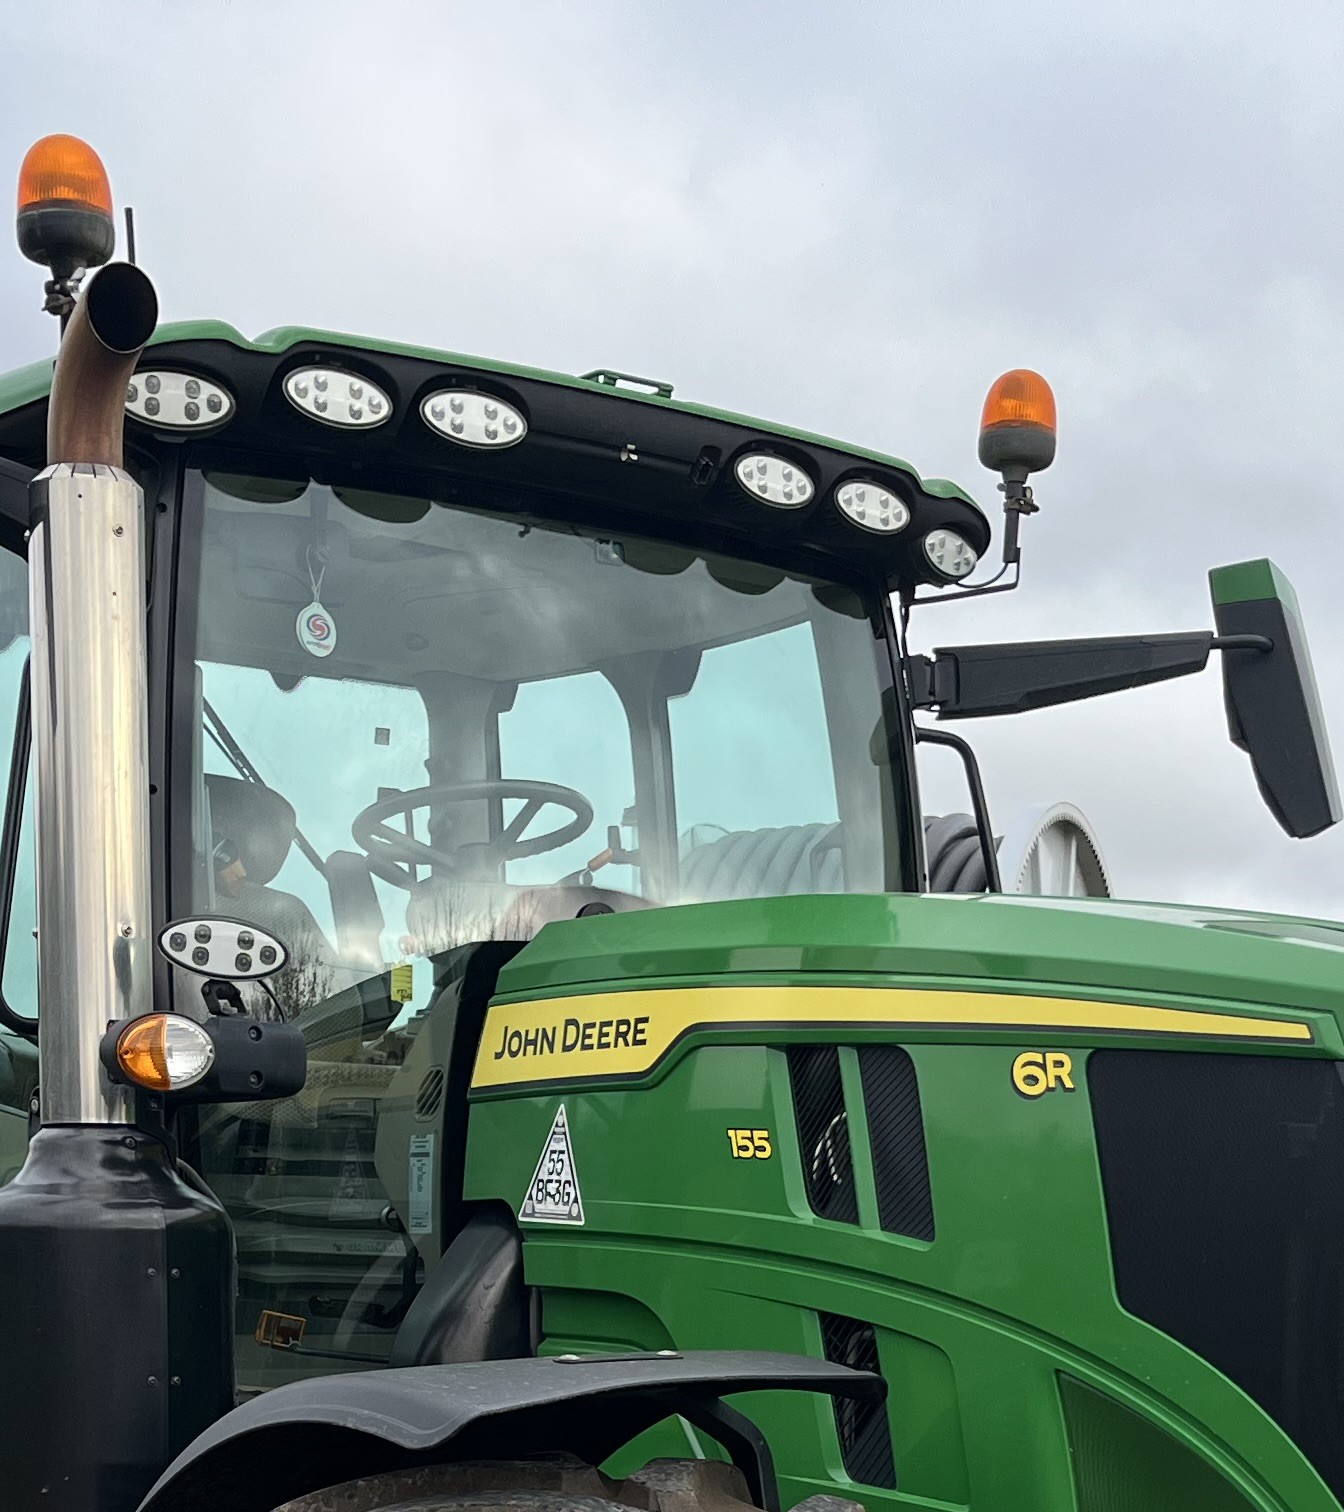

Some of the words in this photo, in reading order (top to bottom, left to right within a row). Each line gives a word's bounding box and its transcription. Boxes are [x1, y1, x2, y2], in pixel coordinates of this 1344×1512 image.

[494, 1025, 557, 1060] JOHN
[561, 1016, 650, 1053] DEERE
[1011, 1051, 1076, 1101] 6R
[547, 1149, 566, 1176] 55
[727, 1128, 773, 1160] 155
